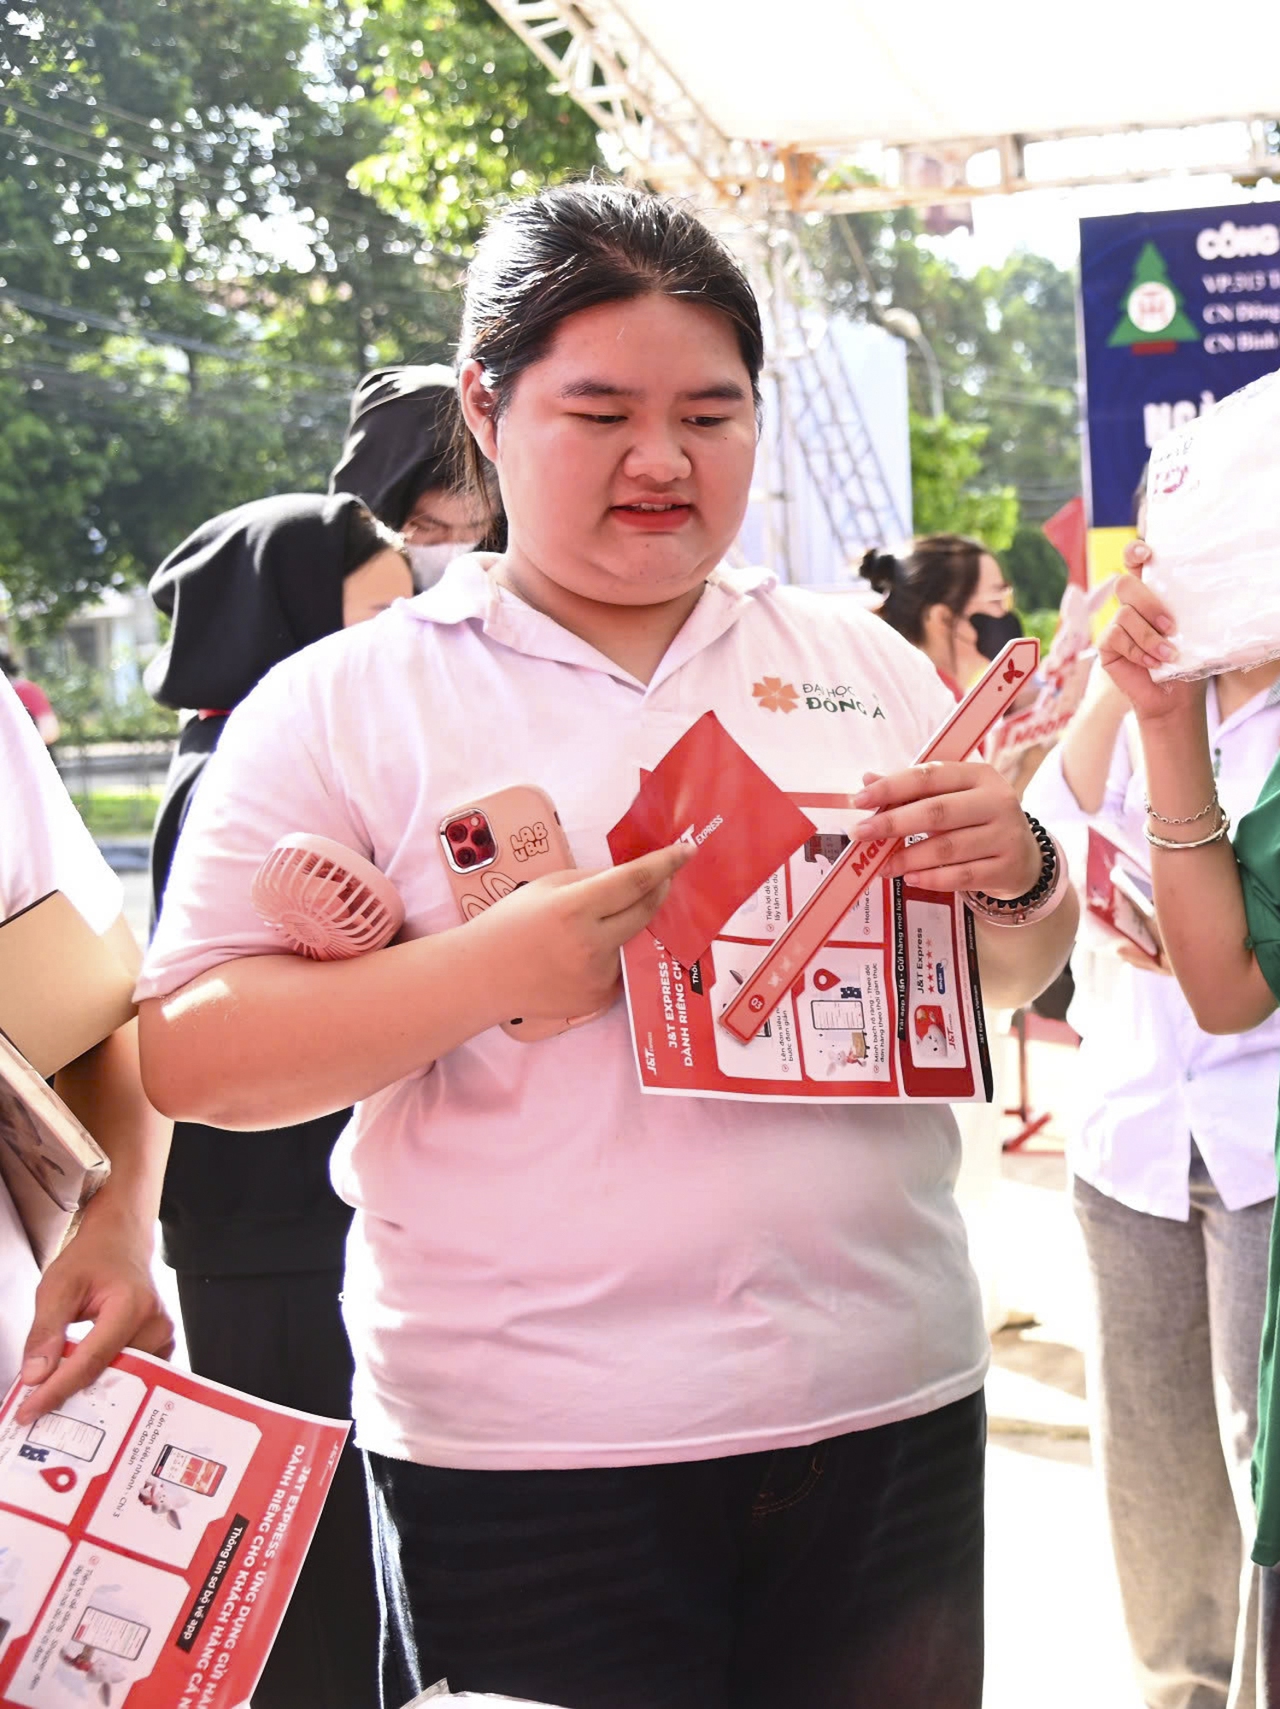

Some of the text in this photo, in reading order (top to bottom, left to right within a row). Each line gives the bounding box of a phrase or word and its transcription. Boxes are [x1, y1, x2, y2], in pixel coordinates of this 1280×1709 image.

[1197, 221, 1280, 260] CÔNG
[1203, 304, 1234, 324] CN
[1204, 333, 1234, 354] CN
[916, 928, 925, 970] Express
[659, 962, 674, 1021] EXPRESS
[672, 957, 693, 1067] DÀNH RIÊNG CH
[667, 1024, 677, 1049] J&T
[279, 1444, 305, 1488] DÀNH
[258, 1488, 286, 1533] RIÊNG
[265, 1495, 300, 1559] EXPRESS
[218, 1527, 244, 1559] Thông
[242, 1534, 265, 1567] CHO
[217, 1569, 249, 1624] KHÁCH
[183, 1618, 199, 1641] app
[196, 1625, 225, 1671] HÀNG
